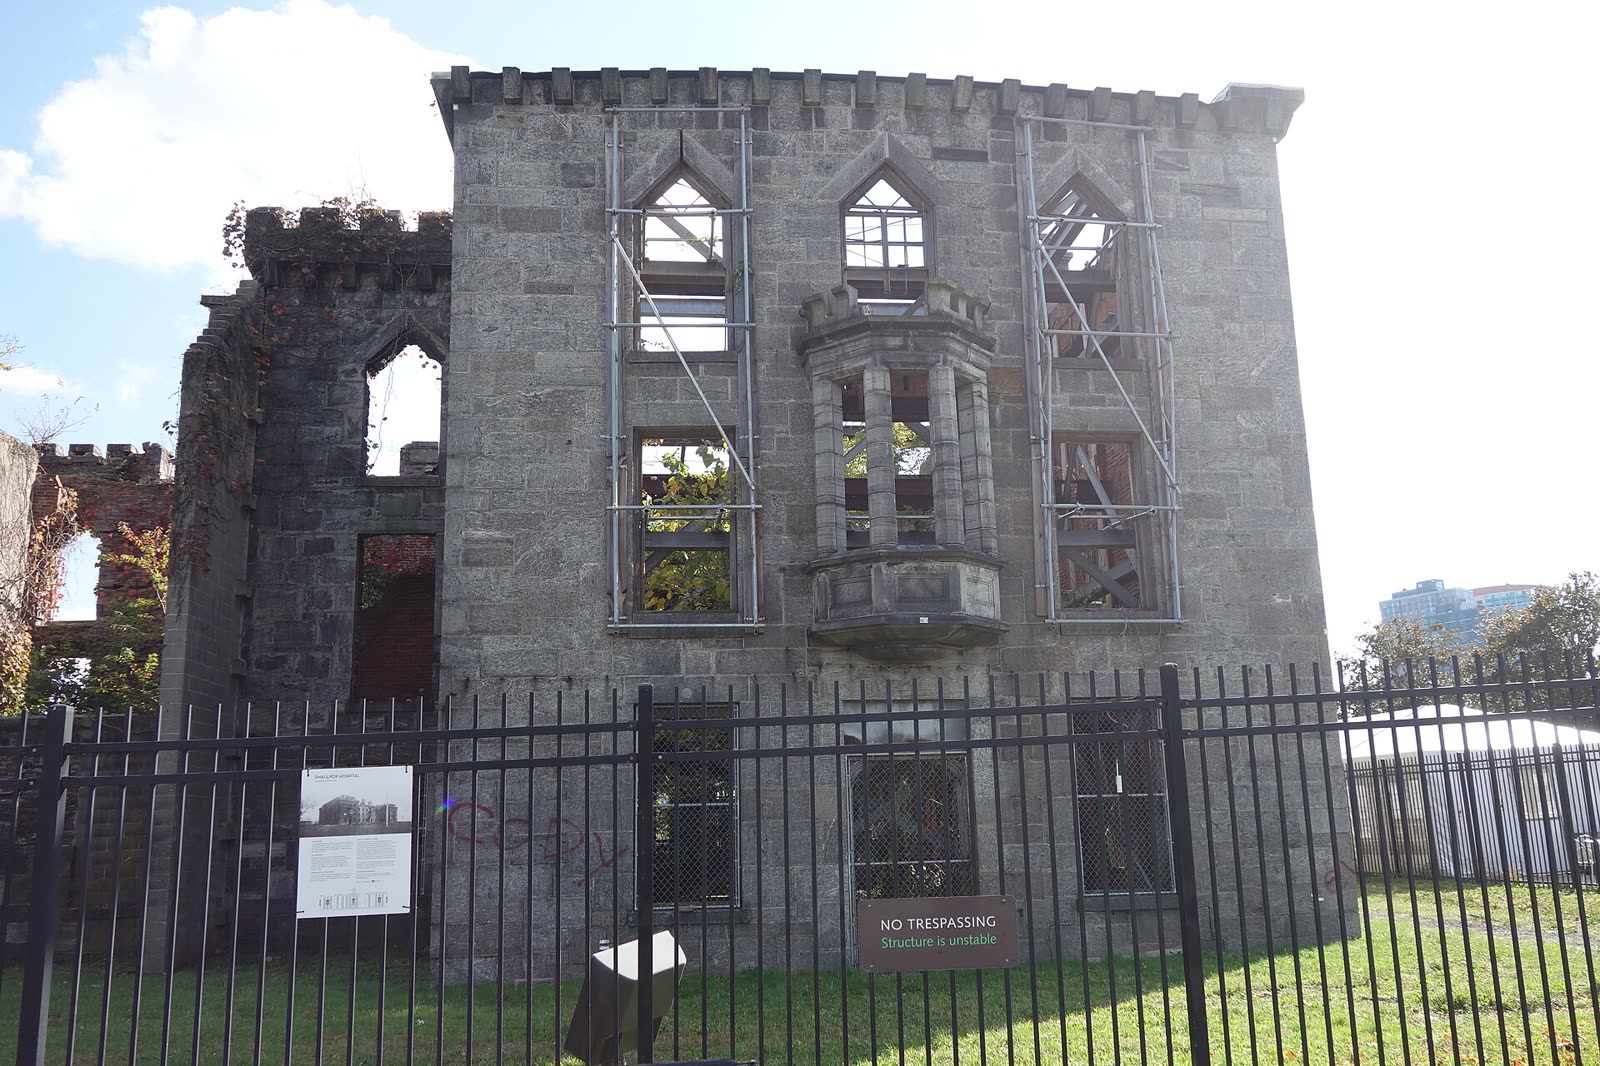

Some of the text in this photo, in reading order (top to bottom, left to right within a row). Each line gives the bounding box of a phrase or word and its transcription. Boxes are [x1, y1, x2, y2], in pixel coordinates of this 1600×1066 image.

[880, 915, 996, 931] NO TRESPASSING
[881, 933, 997, 949] Structure is unstable
